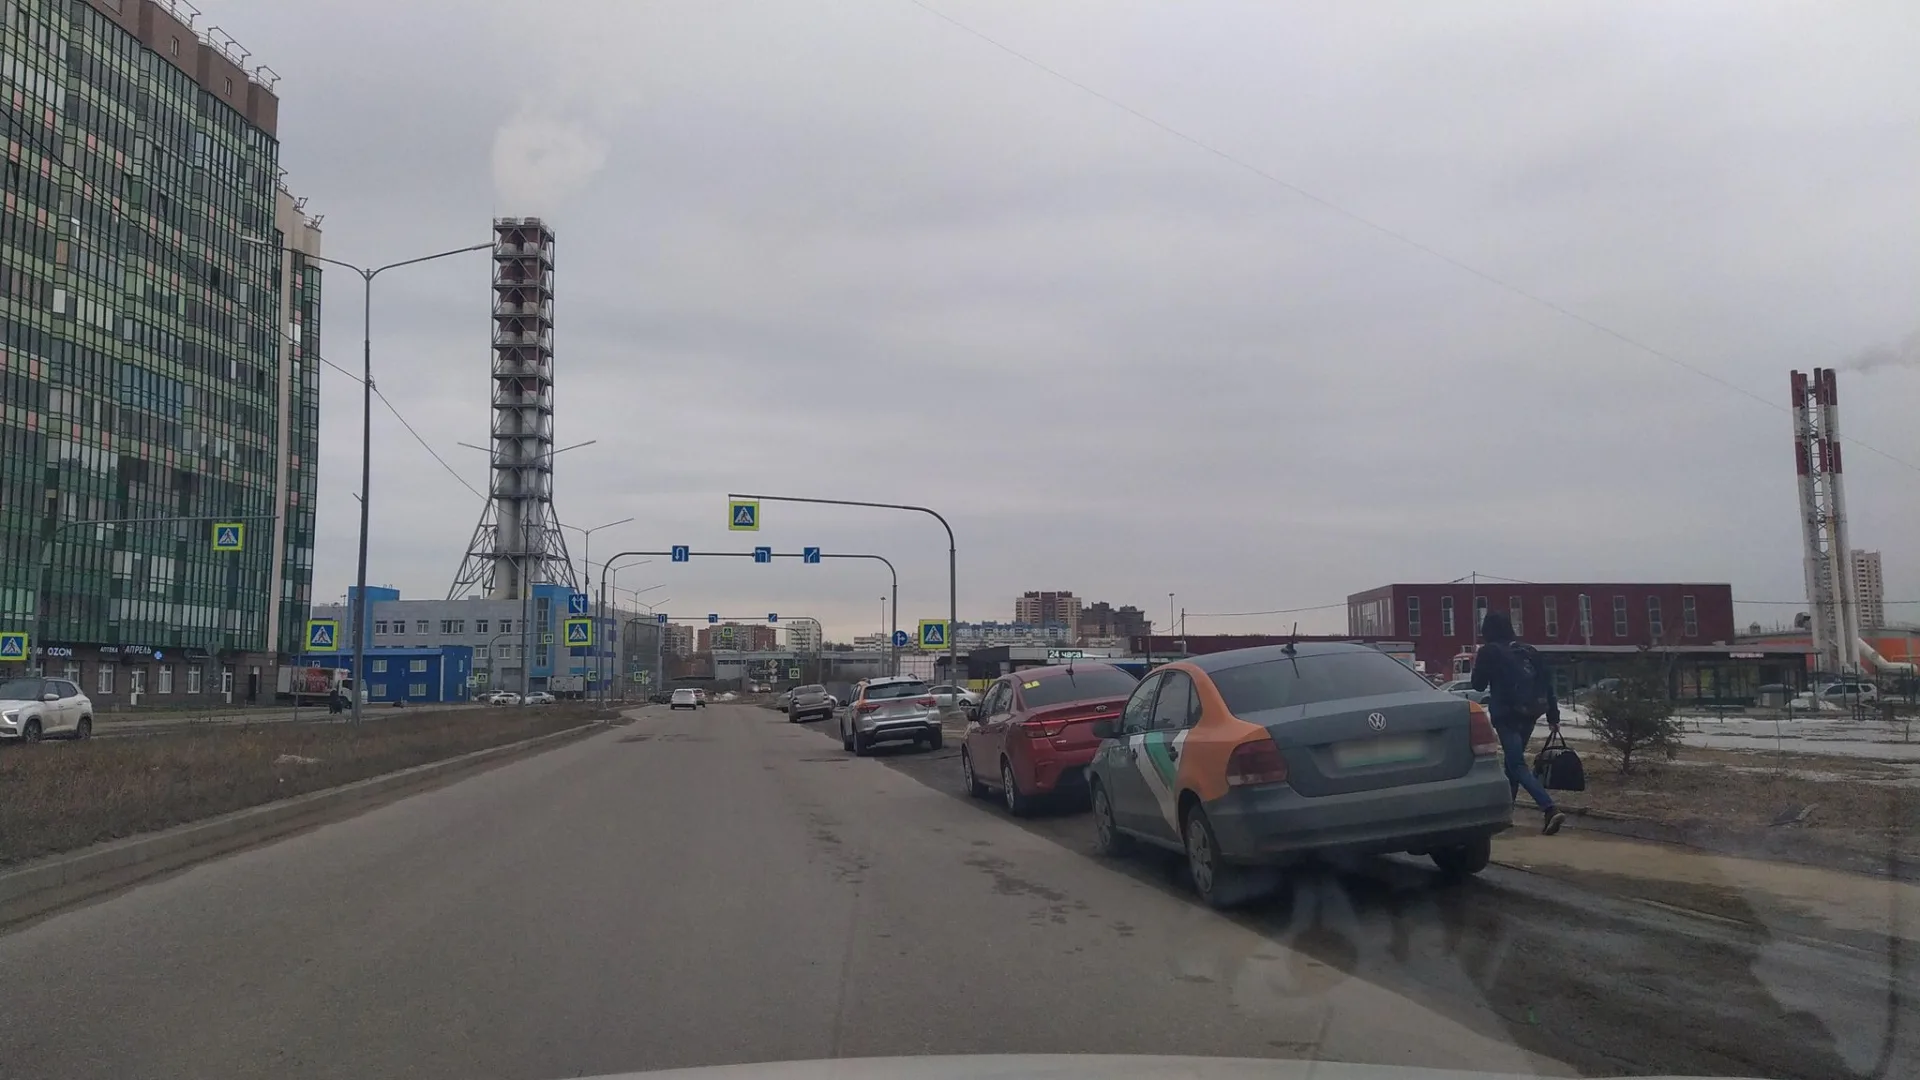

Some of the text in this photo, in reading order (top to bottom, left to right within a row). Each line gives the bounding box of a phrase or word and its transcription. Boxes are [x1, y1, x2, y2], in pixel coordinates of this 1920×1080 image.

[47, 647, 73, 656] OZON
[124, 645, 152, 654] АПРЕЛЬ
[1049, 650, 1060, 658] 24
